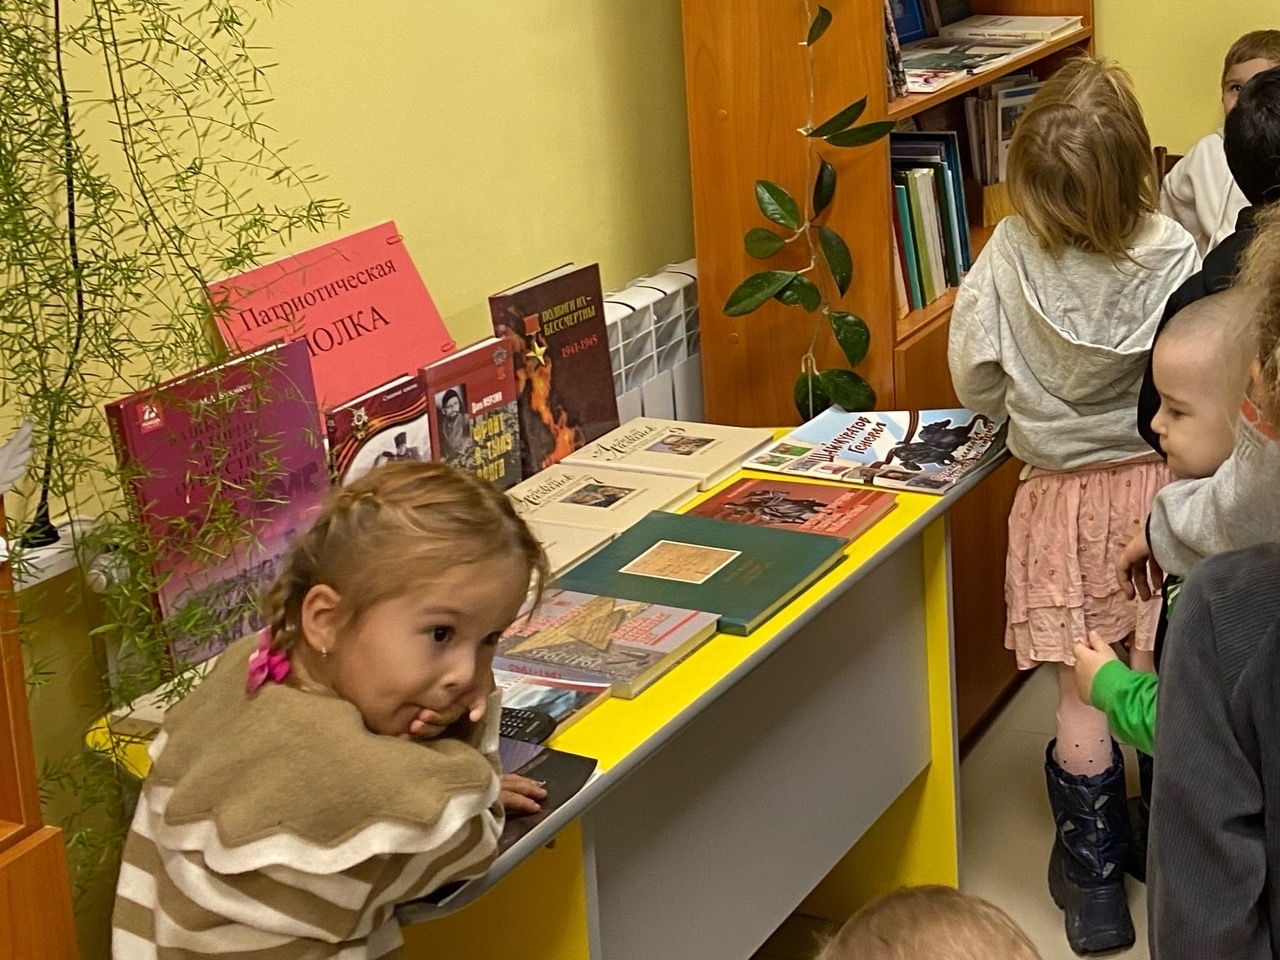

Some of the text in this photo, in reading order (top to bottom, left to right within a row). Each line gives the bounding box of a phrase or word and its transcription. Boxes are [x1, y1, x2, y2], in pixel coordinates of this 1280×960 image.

[237, 258, 397, 332] Патриотическая
[541, 299, 576, 323] ПОДВИГИ
[543, 305, 596, 337] БЕССМЕРТНЫ
